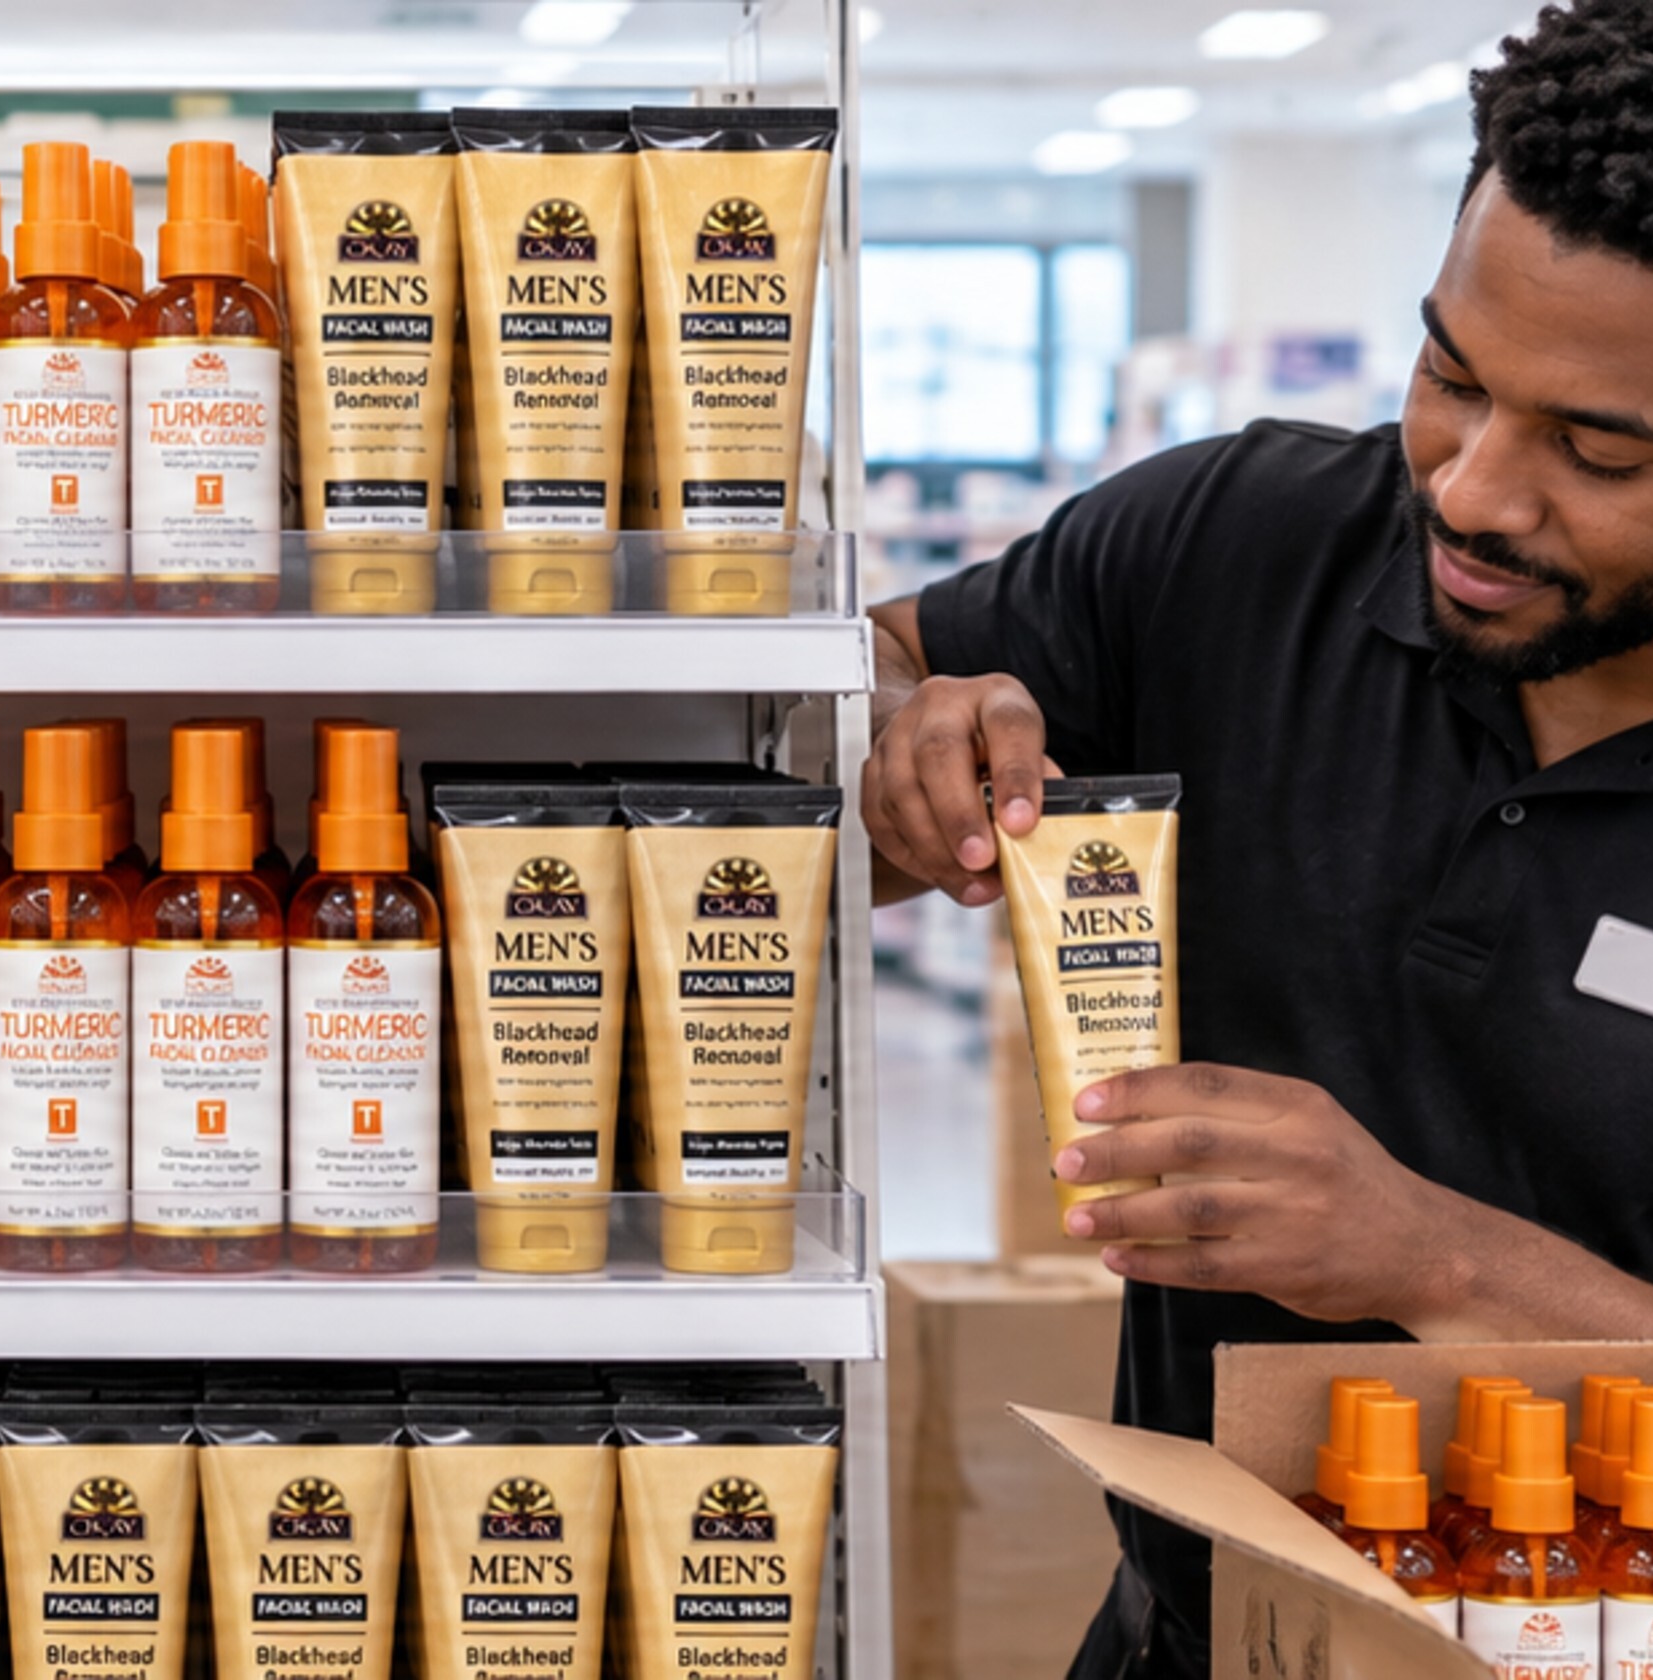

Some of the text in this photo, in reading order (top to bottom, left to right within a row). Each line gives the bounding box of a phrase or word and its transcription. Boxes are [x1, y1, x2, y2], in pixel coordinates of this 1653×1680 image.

[328, 276, 429, 306] MEN'S
[507, 276, 607, 306] MEN'S
[686, 274, 787, 304] MEN'S
[328, 366, 428, 387] Blackhead
[504, 366, 608, 387] Blackhead
[686, 366, 787, 387] Blackhead
[148, 403, 267, 429] TURMERIC
[56, 480, 72, 500] T
[201, 480, 218, 500] T
[1061, 906, 1154, 938] MEN'S
[494, 931, 599, 962] MEN'S
[685, 931, 789, 962] MEN'S
[0, 1012, 122, 1042] TURMERIC
[150, 1012, 270, 1041] TURMERIC
[306, 1012, 428, 1041] TURMERIC
[493, 1021, 599, 1043] Blackhead
[685, 1021, 790, 1043] Blackhead
[55, 1104, 70, 1128] T
[204, 1105, 219, 1128] T
[360, 1105, 375, 1128] T
[50, 1553, 155, 1584] MEN'S
[258, 1554, 363, 1585] MEN'S
[468, 1554, 574, 1585] MEN'S
[680, 1555, 786, 1585] MEN'S
[256, 1645, 363, 1666] Blackhead
[678, 1647, 787, 1667] Blackhead
